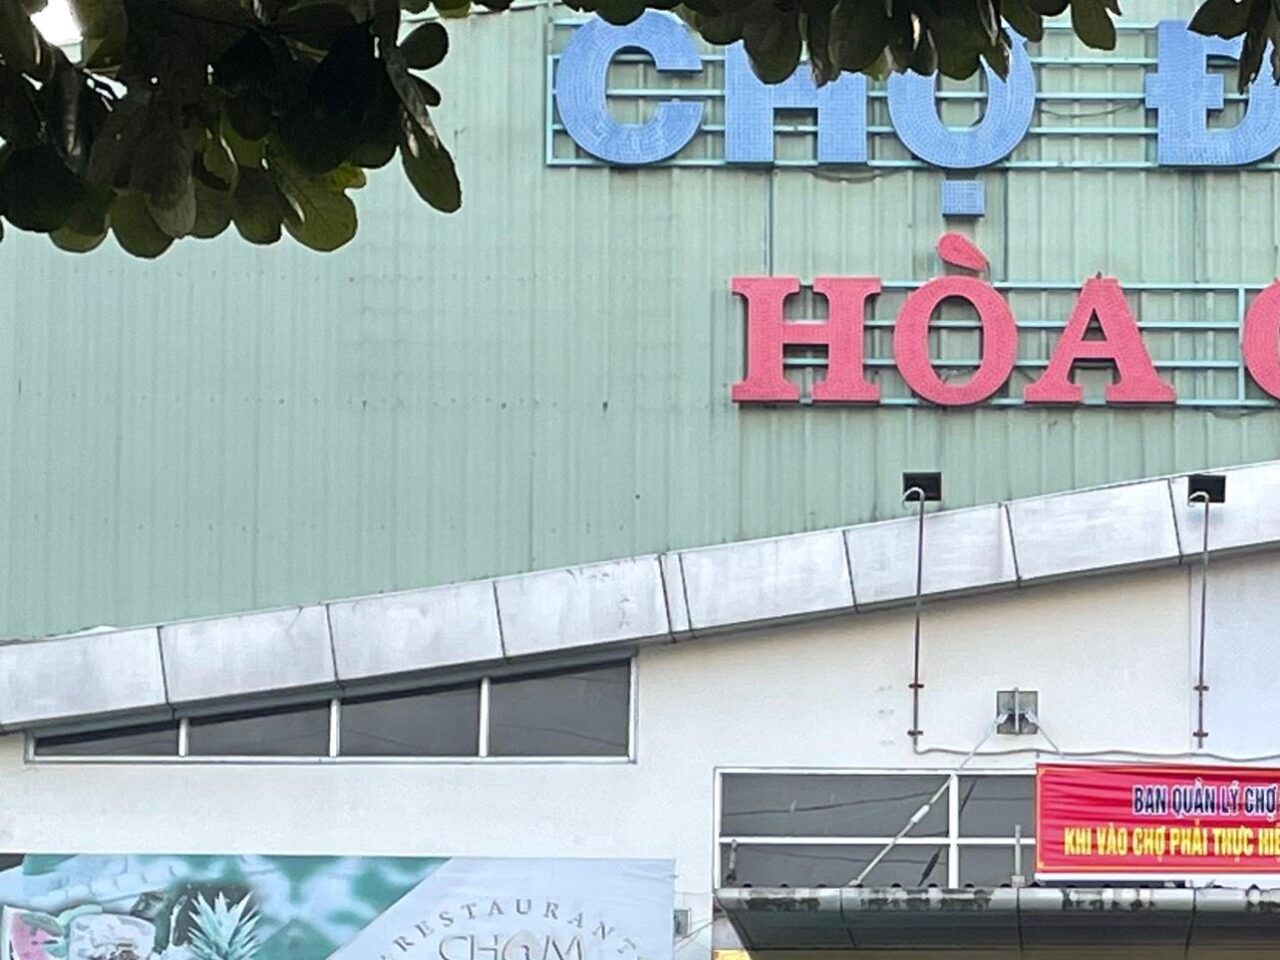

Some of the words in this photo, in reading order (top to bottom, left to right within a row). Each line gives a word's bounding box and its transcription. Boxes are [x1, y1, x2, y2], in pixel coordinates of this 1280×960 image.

[731, 232, 1177, 407] HÒA
[1133, 785, 1167, 816] BAN
[1171, 778, 1216, 818] QUẢN
[1219, 780, 1240, 815] LÝ
[1244, 785, 1277, 822] CHỢ
[1064, 827, 1092, 856] KHI
[1097, 822, 1127, 856] VÀO
[1132, 826, 1165, 862] CHỢ
[1169, 820, 1208, 856] PHẢI
[1212, 826, 1253, 862] THỰC
[393, 899, 637, 956] RESTAURANT
